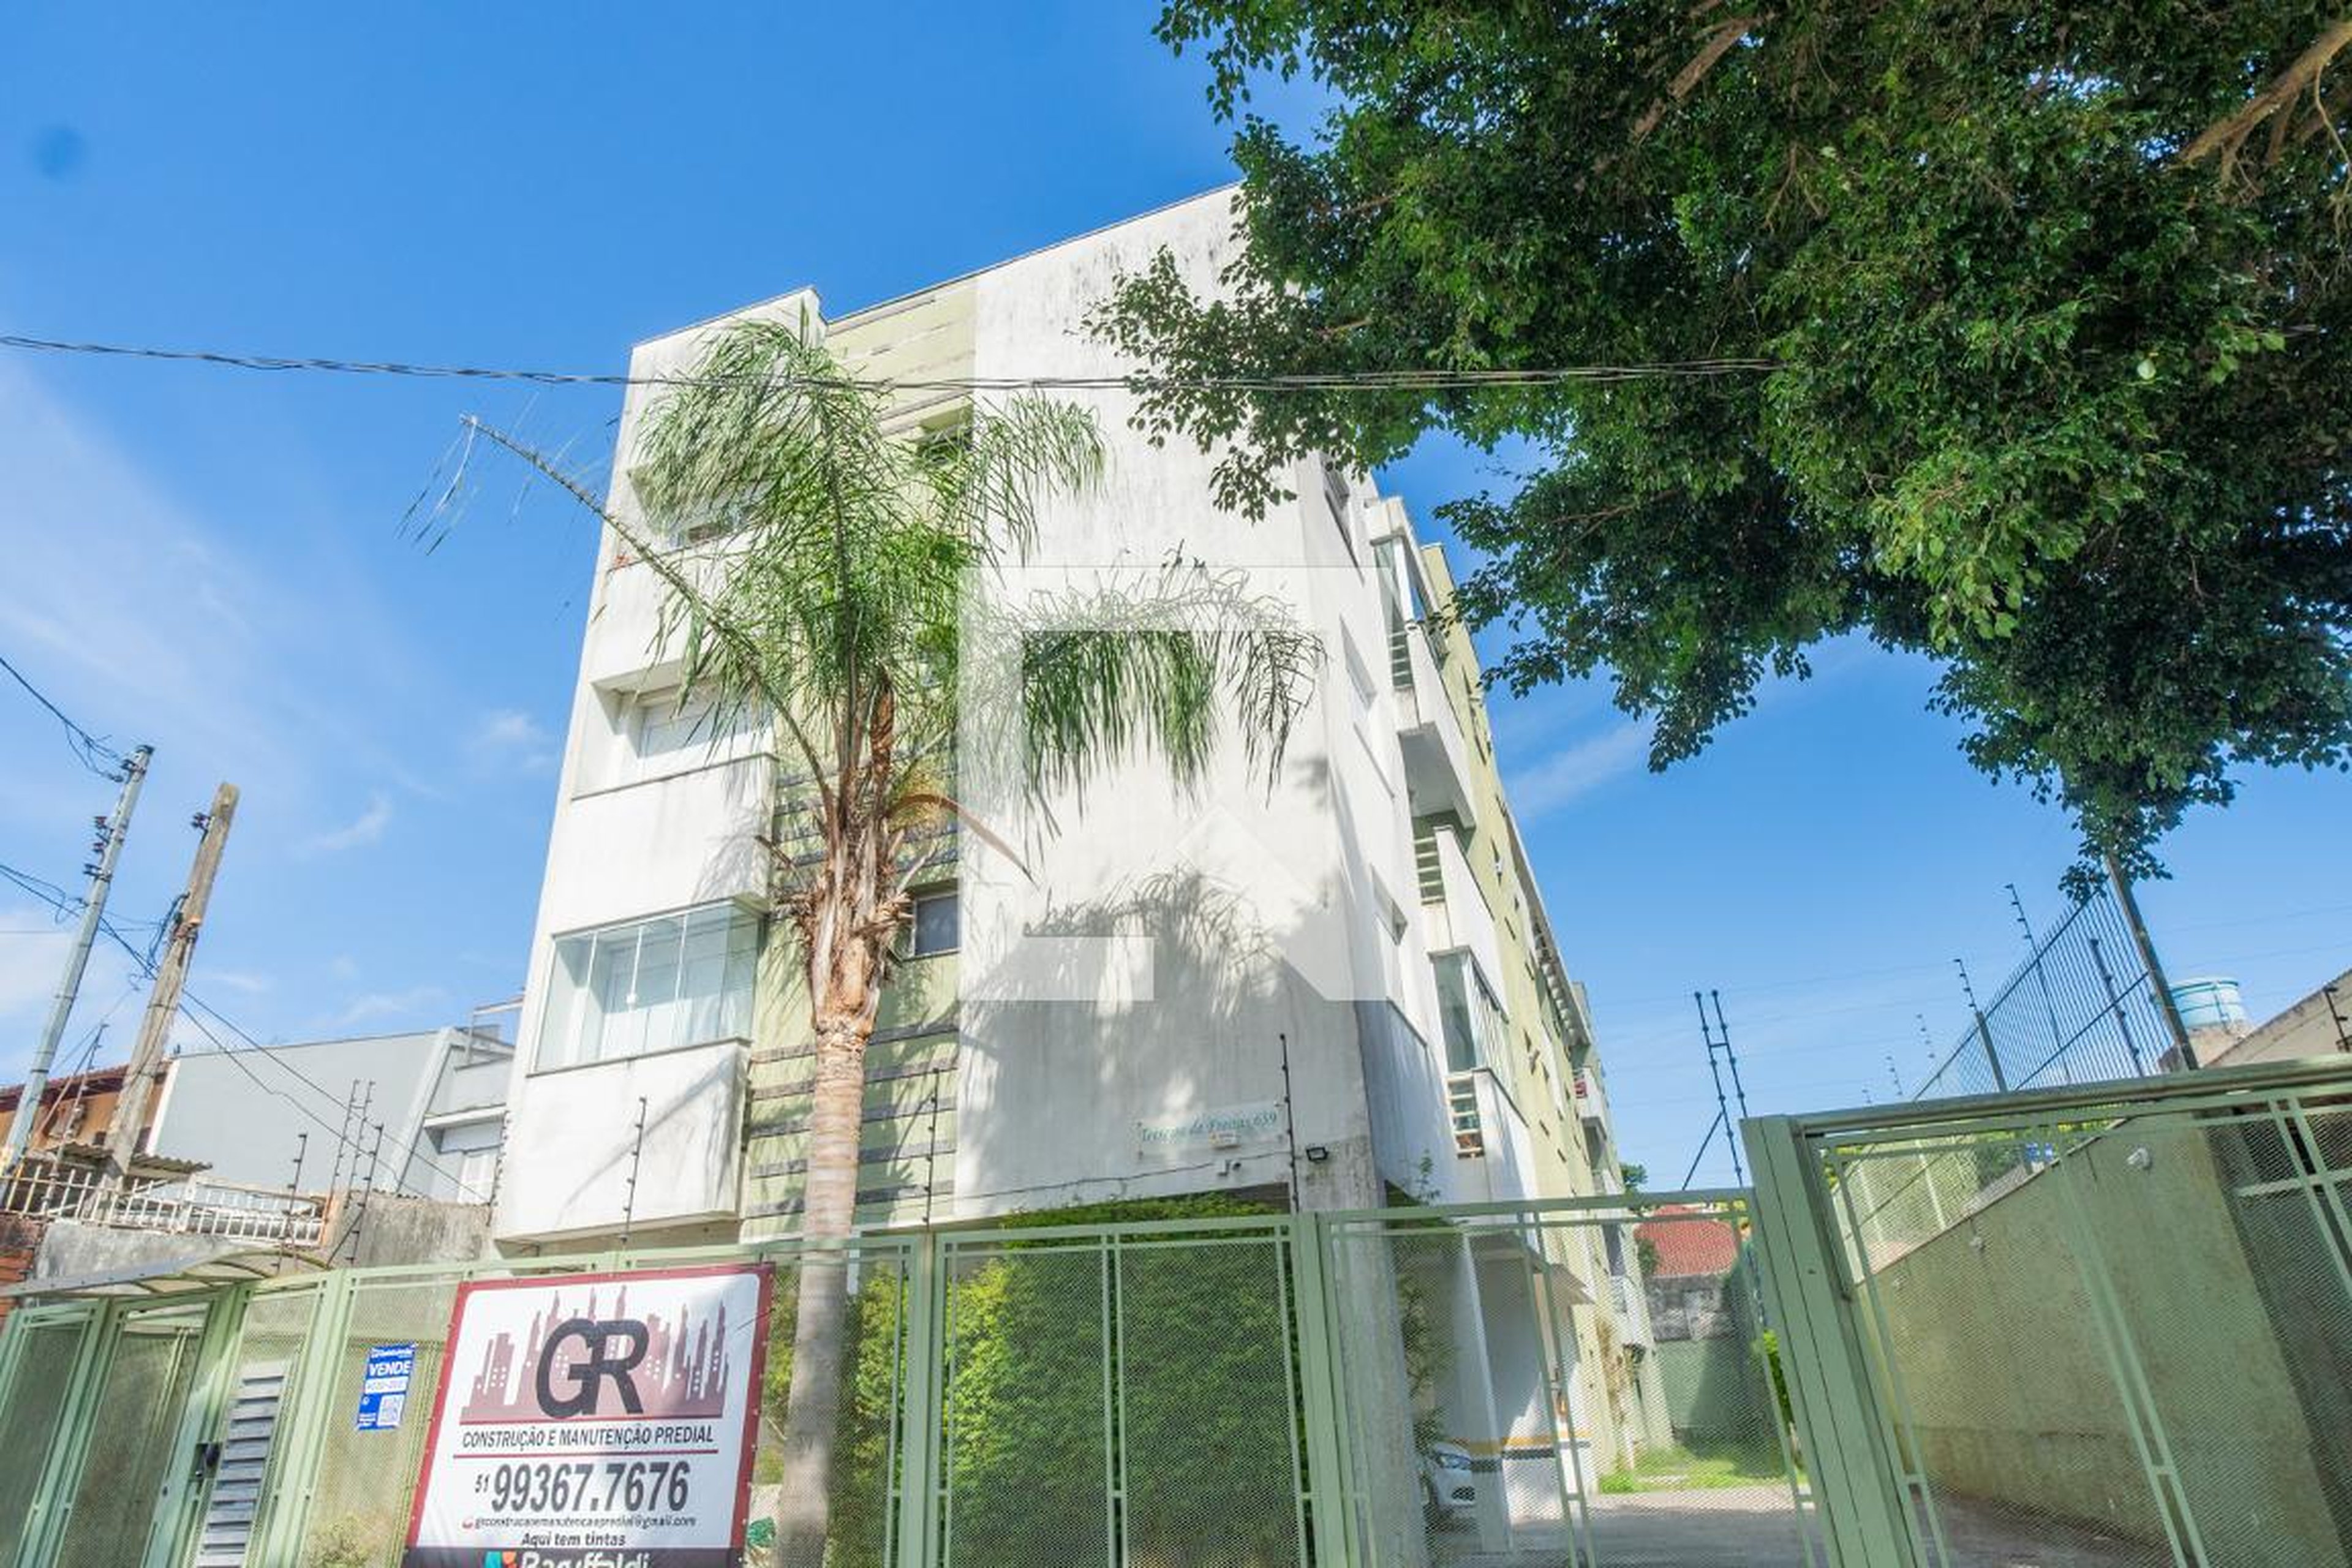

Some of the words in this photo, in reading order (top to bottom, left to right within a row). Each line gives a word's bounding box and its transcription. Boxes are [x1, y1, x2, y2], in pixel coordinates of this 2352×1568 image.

[369, 1360, 412, 1376] VENDE
[537, 1318, 649, 1419] GR
[462, 1426, 545, 1452] CONSTRUÇÃO
[547, 1430, 556, 1446] E
[559, 1423, 652, 1450] MANUTENÇÃO
[654, 1425, 714, 1444] PREDIAL
[475, 1472, 490, 1493] 51
[491, 1461, 690, 1512] 99367.7676
[522, 1531, 551, 1550] Aqui
[554, 1533, 581, 1546] tem
[585, 1532, 626, 1546] tintas
